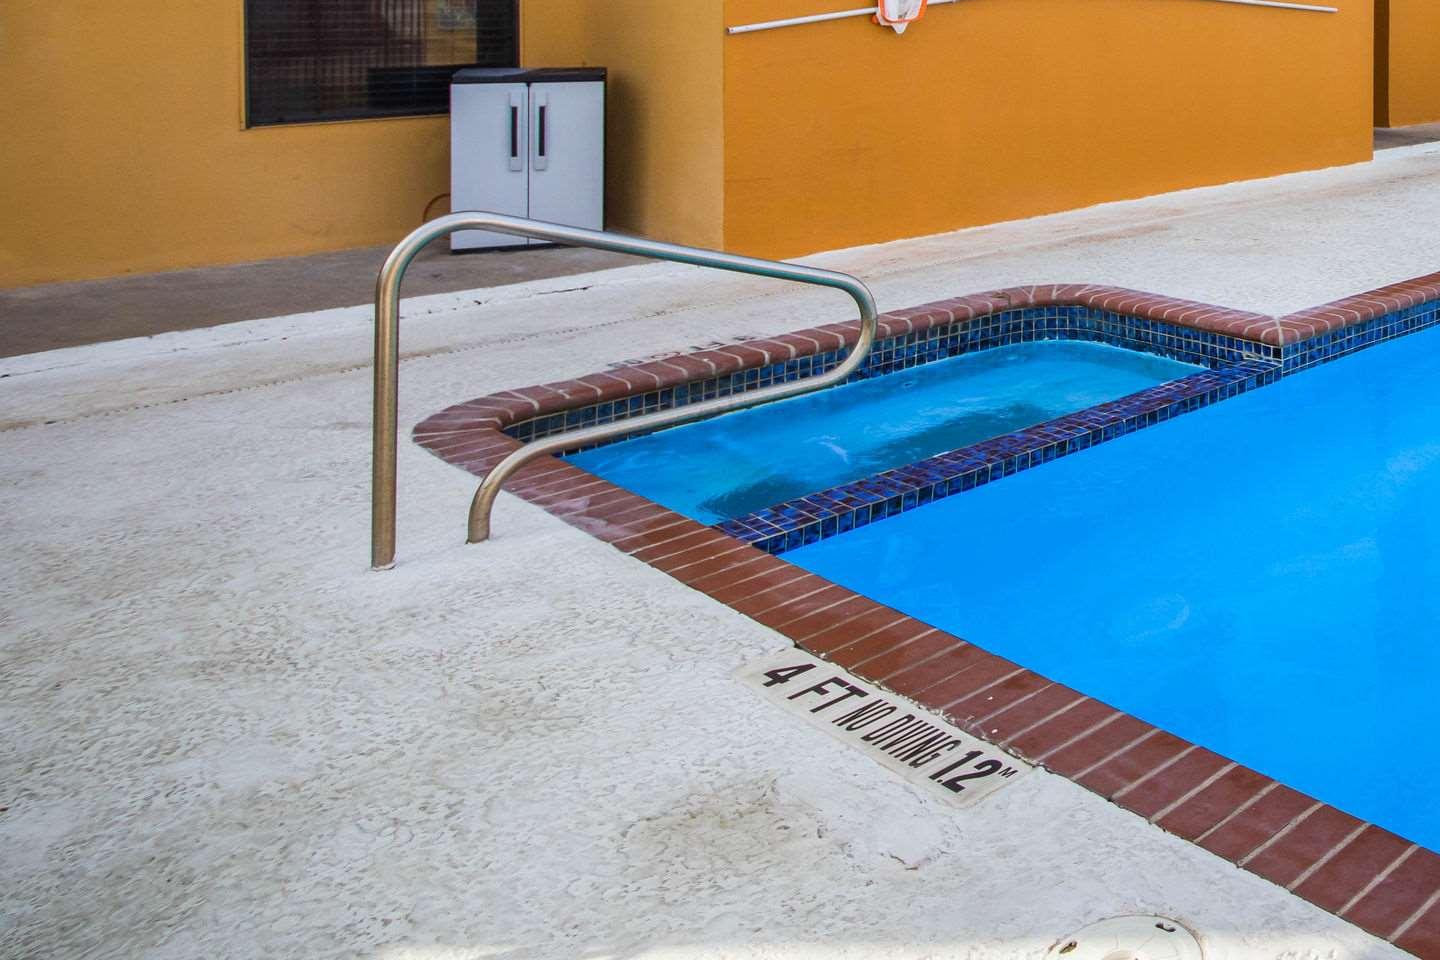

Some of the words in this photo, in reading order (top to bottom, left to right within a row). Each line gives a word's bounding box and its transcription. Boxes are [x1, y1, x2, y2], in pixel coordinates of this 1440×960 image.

[763, 663, 817, 688] 4
[787, 676, 870, 714] FT
[831, 698, 897, 732] NO
[860, 713, 962, 769] DIVING
